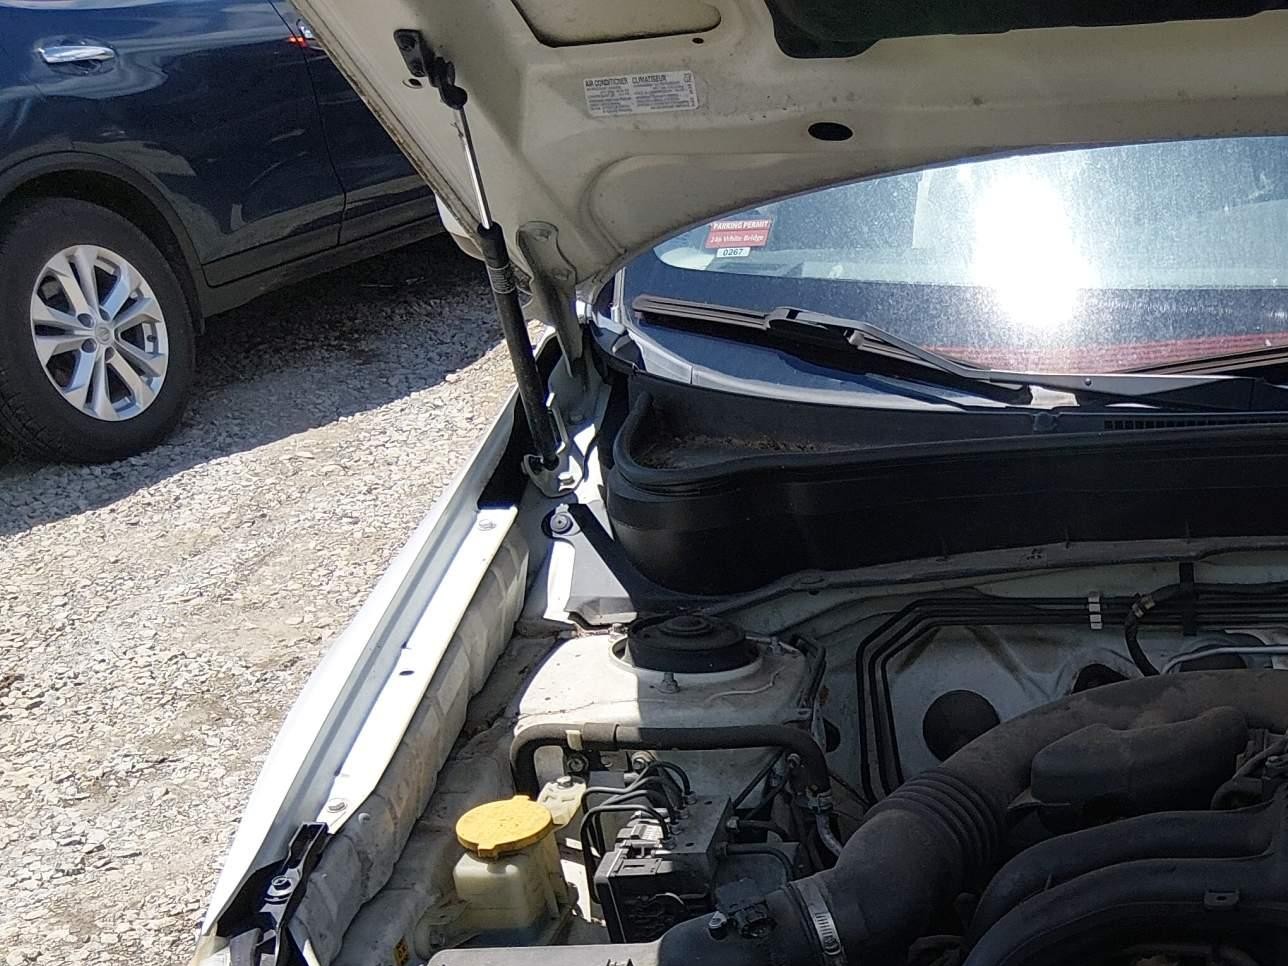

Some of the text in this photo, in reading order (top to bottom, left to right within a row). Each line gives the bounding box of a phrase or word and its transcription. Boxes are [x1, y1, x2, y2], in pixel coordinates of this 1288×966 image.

[713, 220, 769, 230] PARKING PERMIT
[722, 248, 744, 257] 0267
